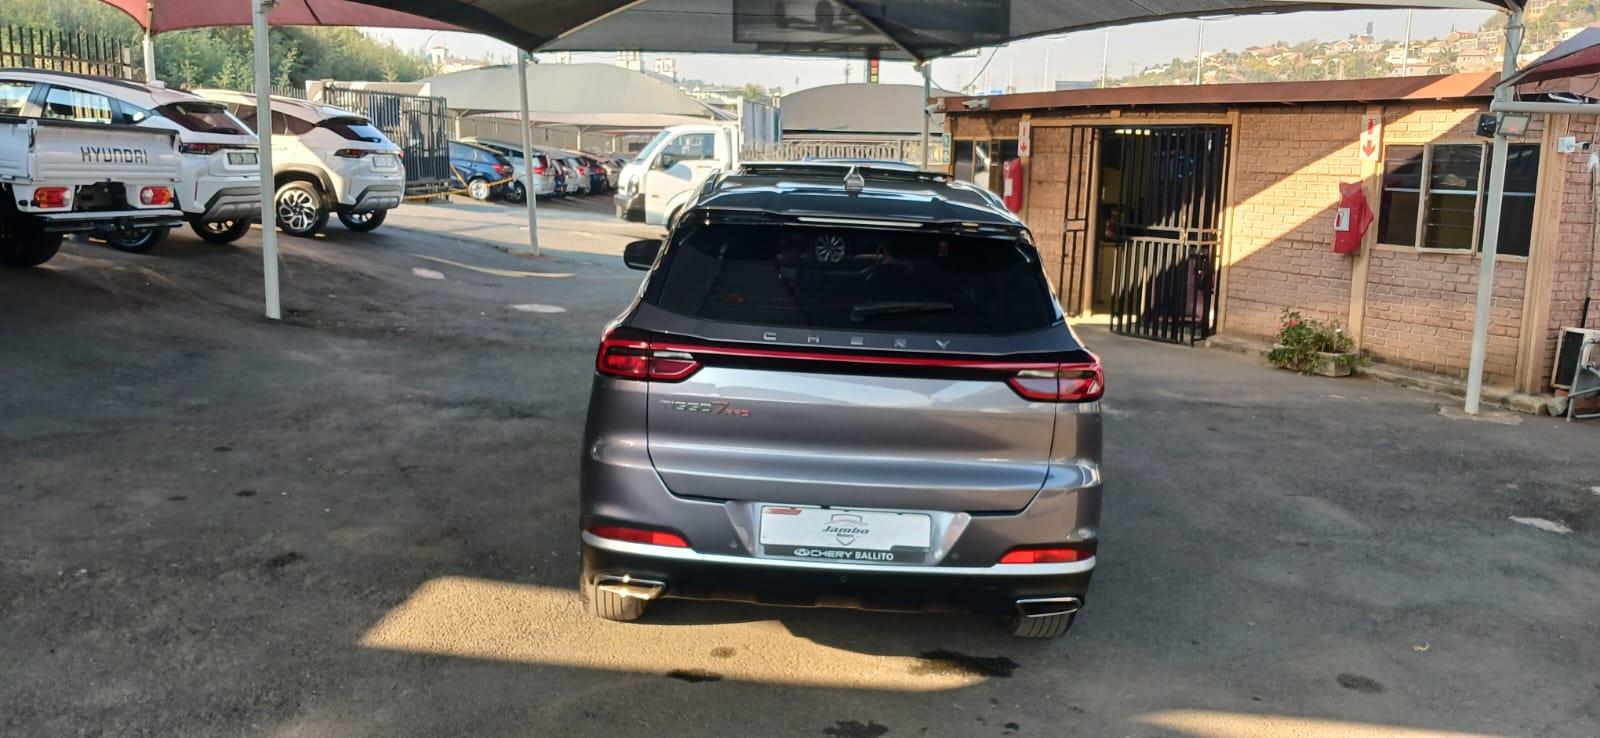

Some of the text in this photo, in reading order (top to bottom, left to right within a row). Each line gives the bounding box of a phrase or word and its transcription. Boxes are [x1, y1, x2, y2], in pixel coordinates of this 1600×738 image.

[80, 146, 149, 164] HYUNDAI
[762, 331, 951, 350] CHERY
[822, 526, 870, 535] Jambo
[810, 549, 894, 561] CHERY BALLITO
